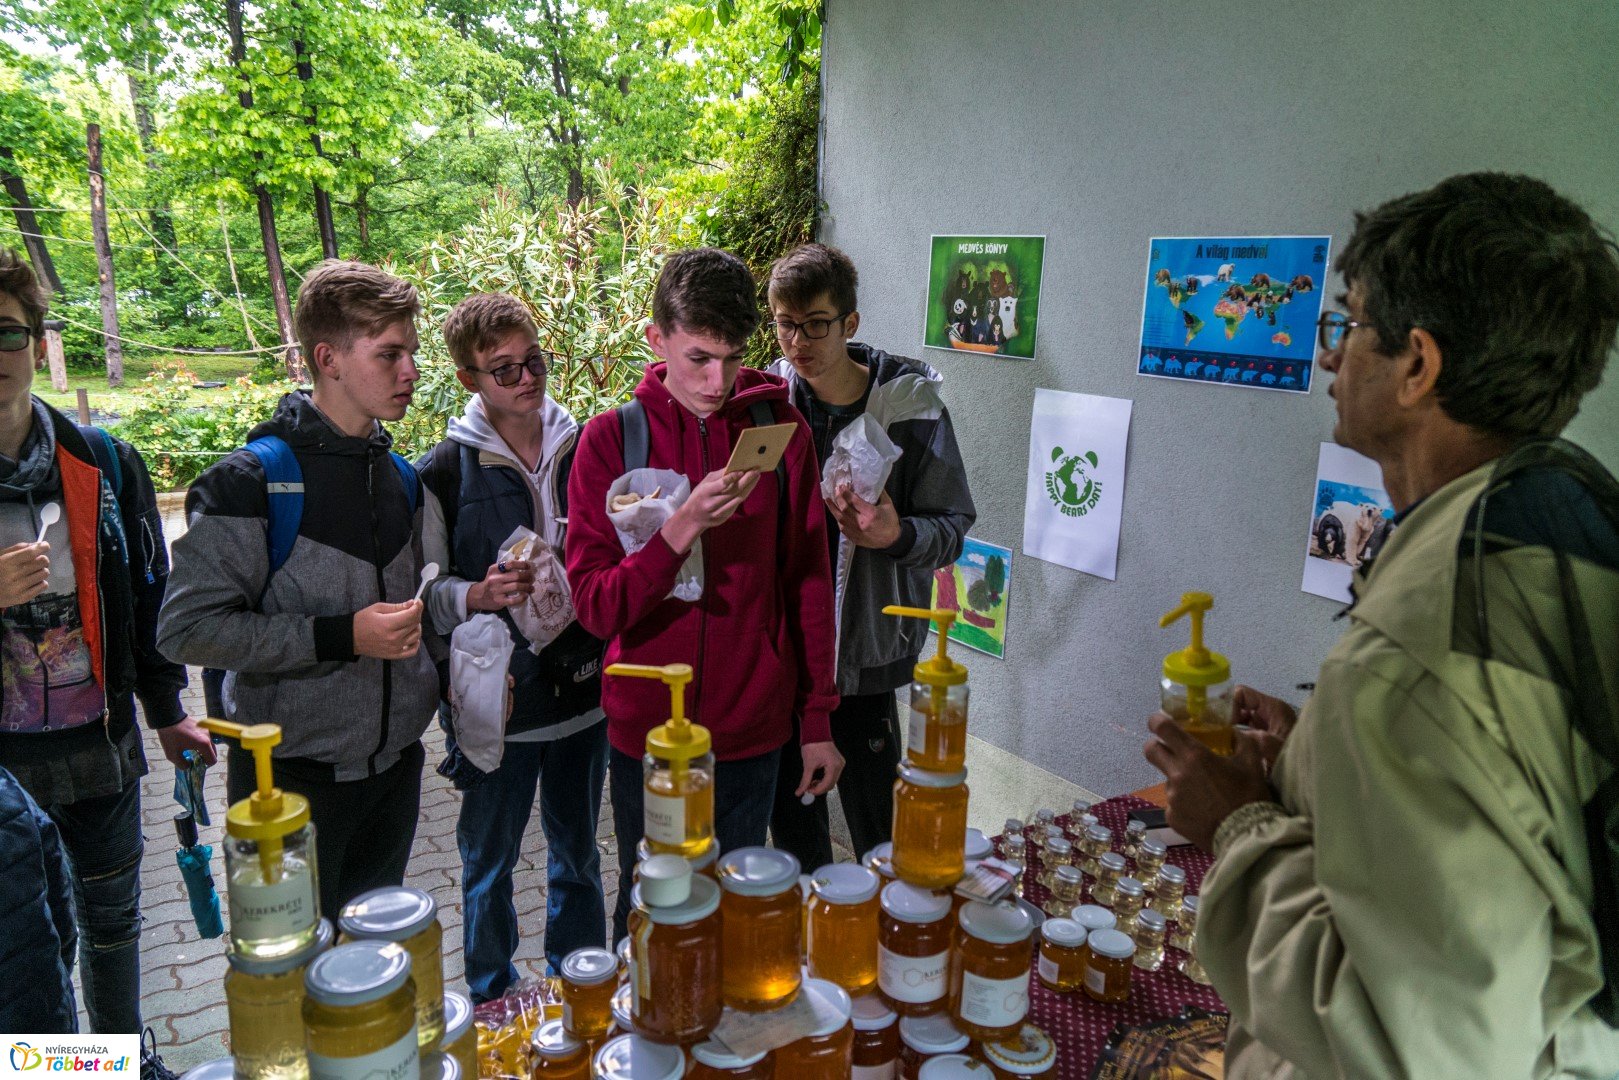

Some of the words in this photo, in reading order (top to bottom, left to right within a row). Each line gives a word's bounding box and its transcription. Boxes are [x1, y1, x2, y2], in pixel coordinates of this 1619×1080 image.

[958, 241, 984, 254] MEDVÉS
[985, 242, 1009, 254] KÖNYV
[1196, 244, 1204, 259] A
[1206, 244, 1230, 260] világ
[1045, 471, 1062, 507] HAPPY
[1060, 504, 1088, 517] BEARS
[1087, 481, 1103, 509] DAY!
